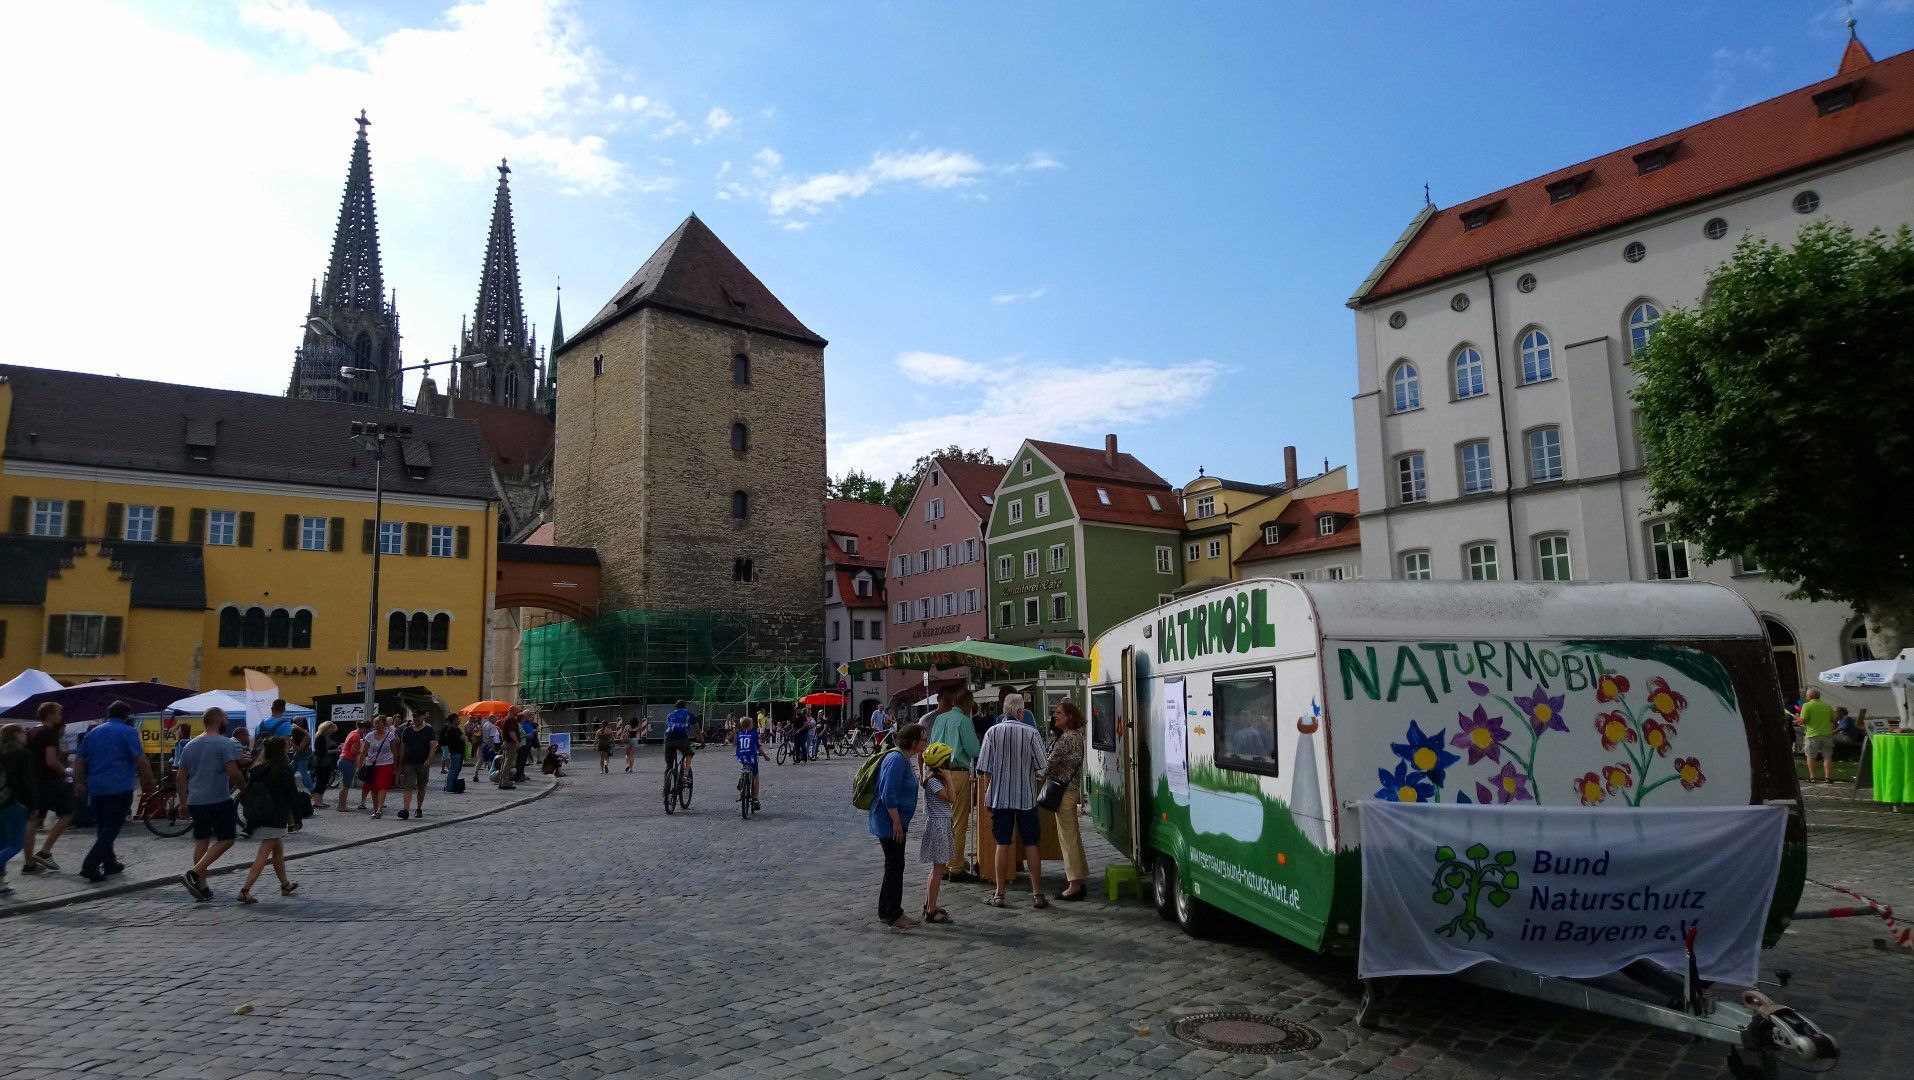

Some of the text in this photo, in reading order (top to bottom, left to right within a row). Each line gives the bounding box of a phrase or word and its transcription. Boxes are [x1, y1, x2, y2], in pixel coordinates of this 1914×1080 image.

[1157, 588, 1276, 664] NATURMOBIL
[275, 665, 318, 677] PLAZA
[446, 666, 468, 676] Dom
[1337, 640, 1617, 703] NATURMOBIL
[739, 737, 750, 750] 10
[1532, 849, 1610, 876] Bund
[1529, 885, 1707, 911] Naturschutz
[1520, 918, 1547, 941] in
[1554, 920, 1648, 946] Bayern
